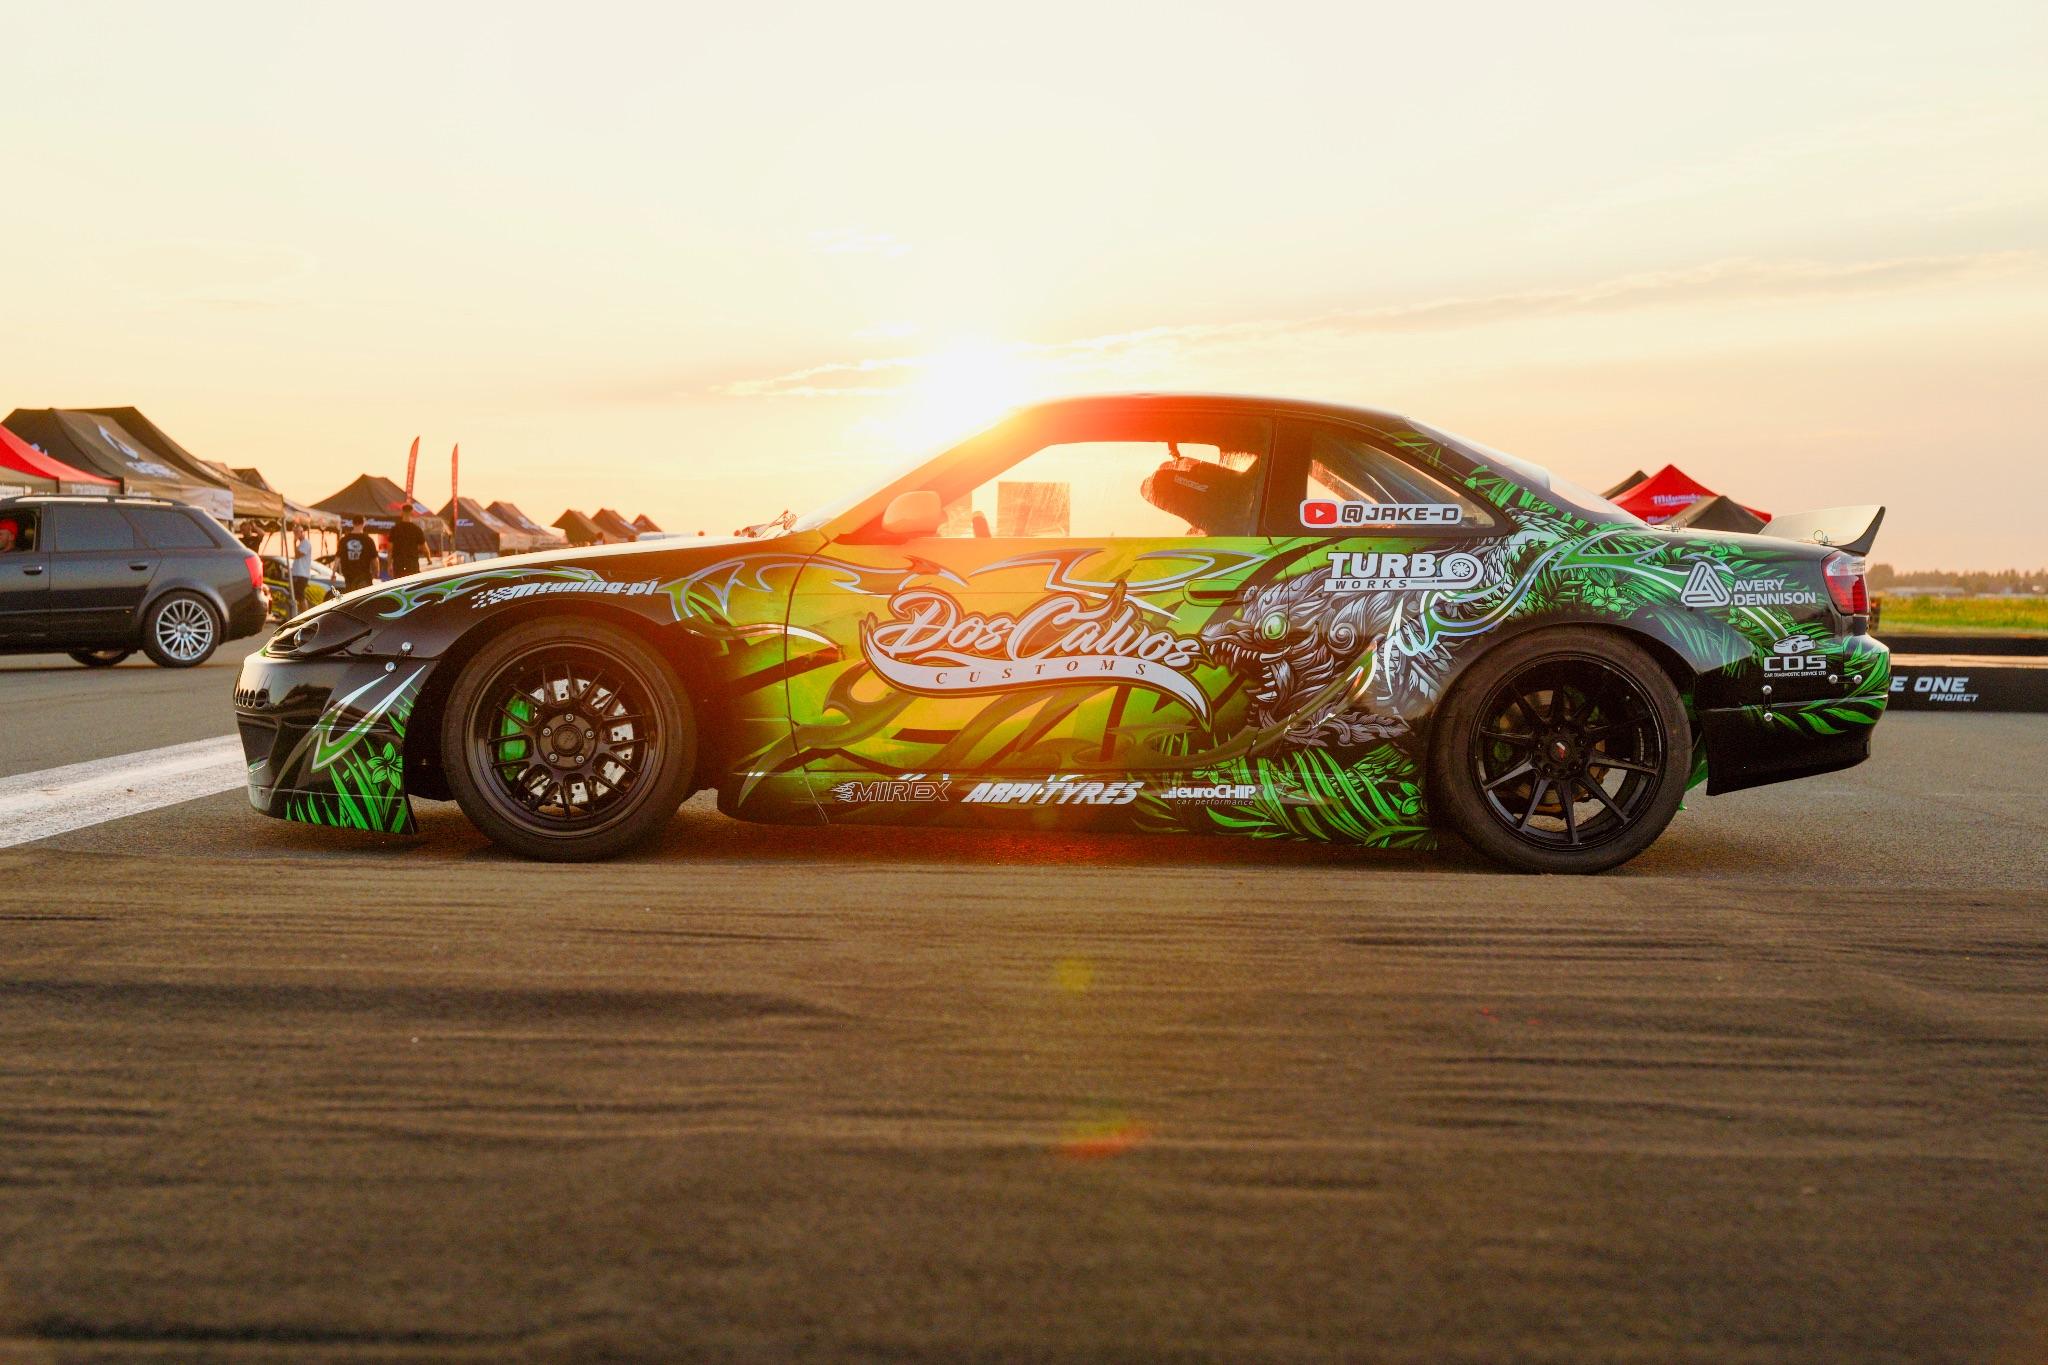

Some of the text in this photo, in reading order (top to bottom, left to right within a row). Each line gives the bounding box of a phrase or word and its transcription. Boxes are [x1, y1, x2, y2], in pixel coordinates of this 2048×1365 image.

[1342, 504, 1459, 523] @JAKE-D
[1327, 552, 1484, 590] TURBO
[1335, 579, 1408, 590] WORKS
[1733, 579, 1785, 592] AVERY
[1733, 592, 1817, 606] DENNISON
[873, 590, 1206, 667] Dos Calvos
[935, 659, 1147, 685] CUSTOMS
[1914, 676, 1969, 693] ONE
[1929, 693, 1979, 702] PROJECT
[1176, 784, 1257, 799] euroCHIP
[1194, 799, 1254, 807] performance
